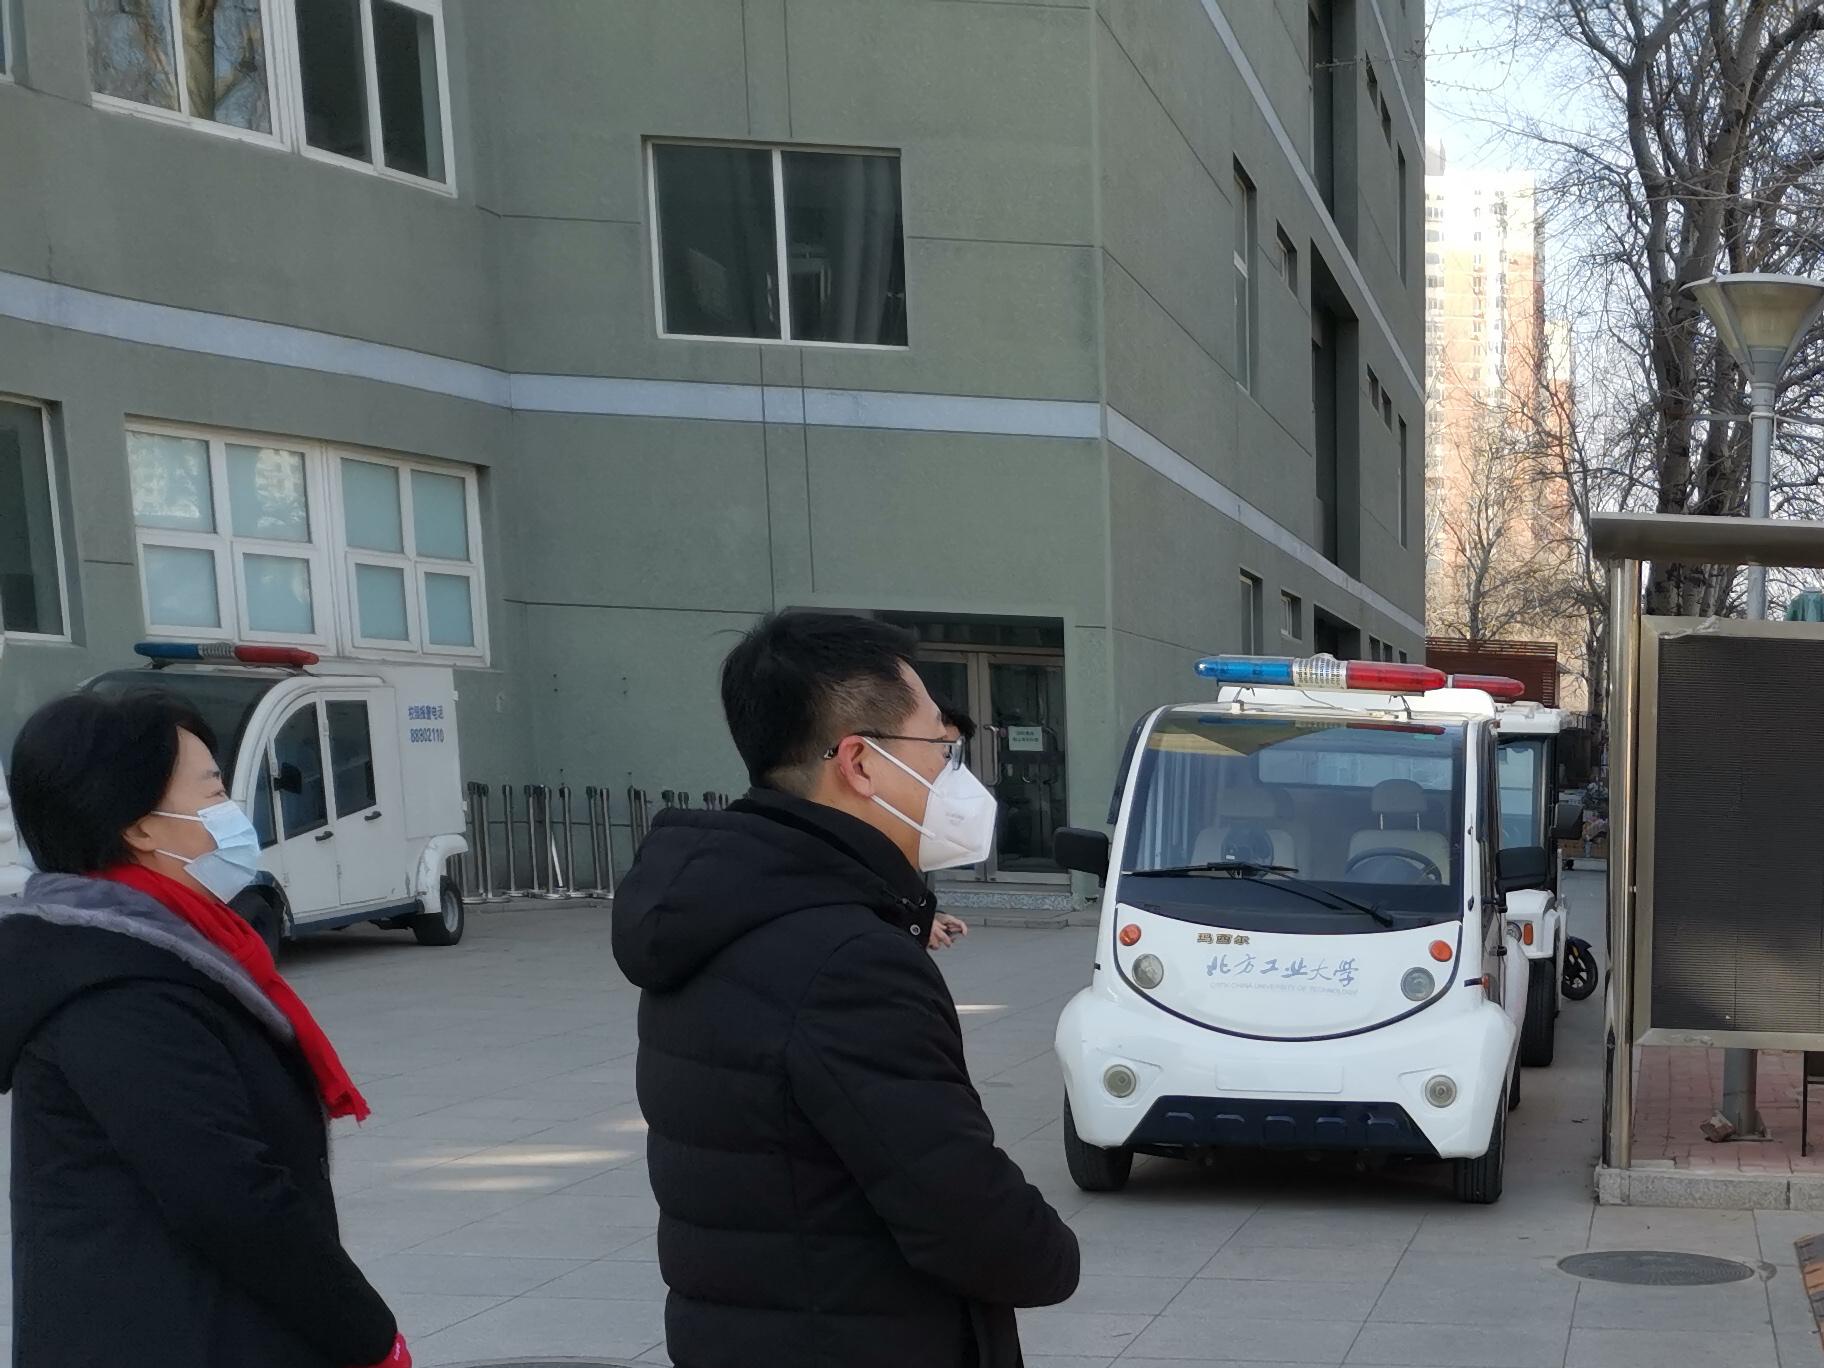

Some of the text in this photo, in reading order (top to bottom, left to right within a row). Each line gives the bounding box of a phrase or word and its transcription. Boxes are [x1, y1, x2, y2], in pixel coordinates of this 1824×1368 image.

[1206, 953, 1359, 988] 北方工业大学
